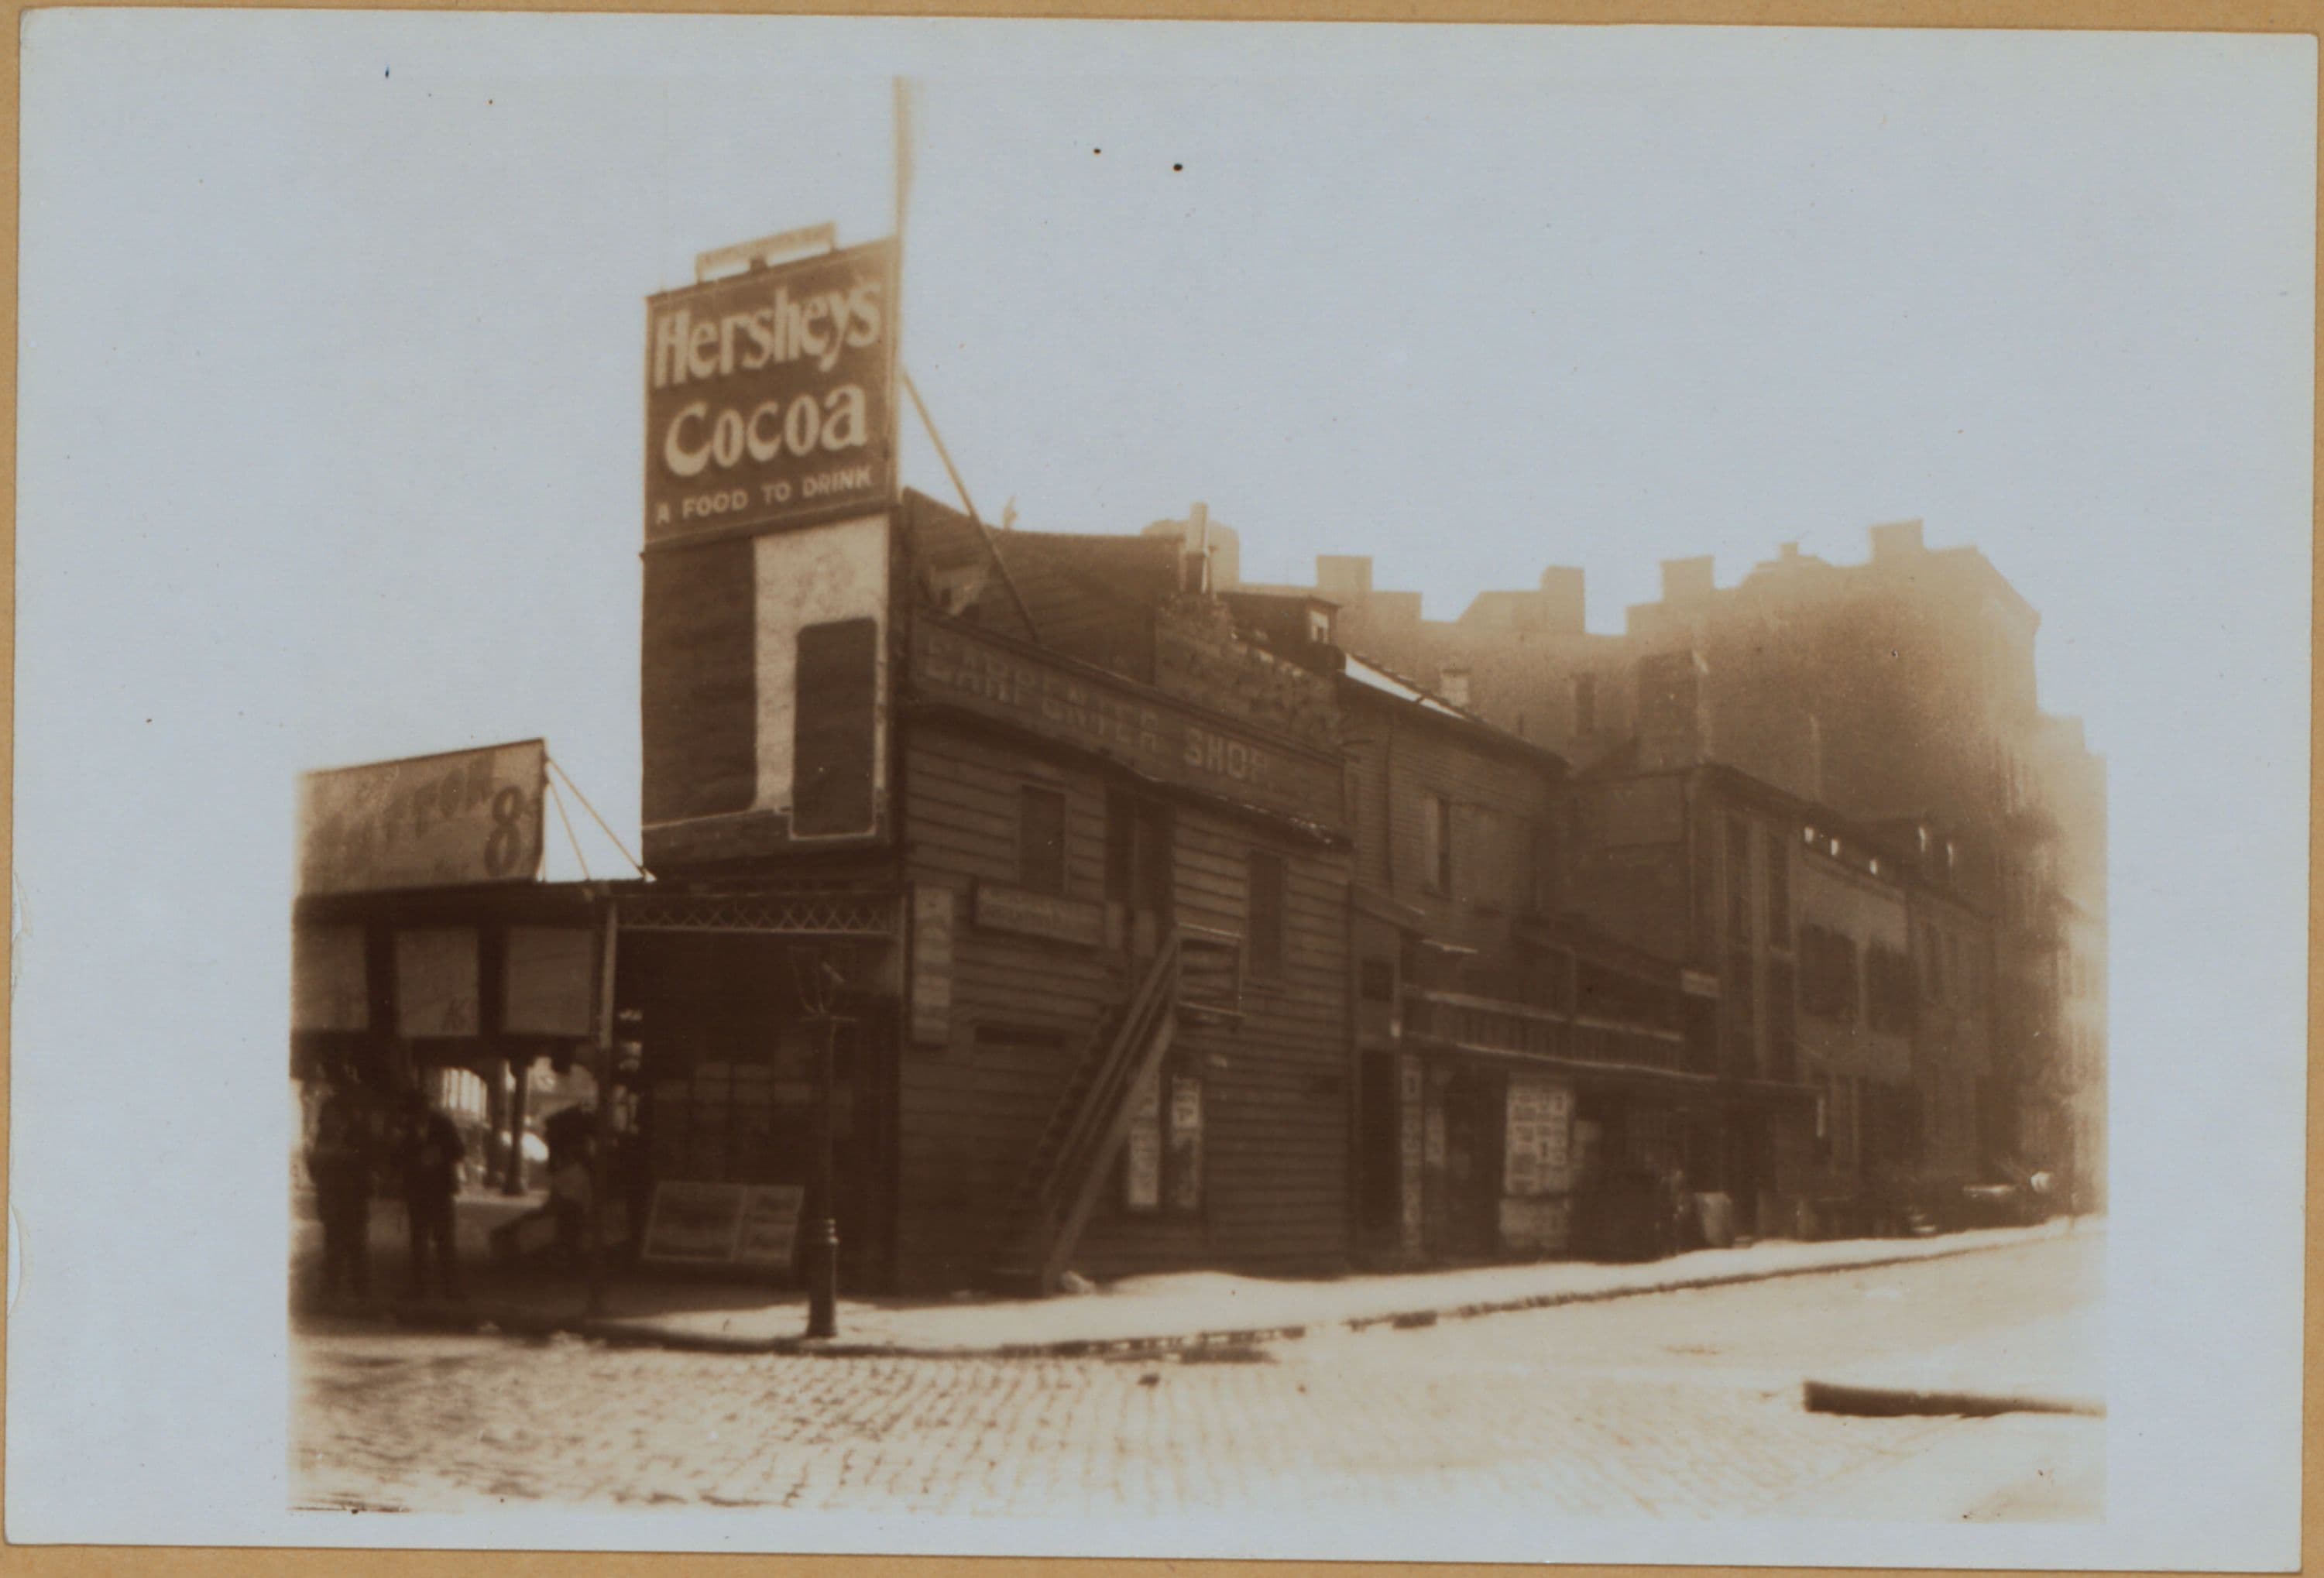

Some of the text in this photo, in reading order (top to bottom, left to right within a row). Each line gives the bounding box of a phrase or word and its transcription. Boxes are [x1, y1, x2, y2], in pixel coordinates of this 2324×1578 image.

[664, 384, 867, 476] Cocoa
[656, 465, 874, 526] A FOOD TO DRINK
[1183, 725, 1271, 783] SHOP
[483, 786, 521, 877] 8
